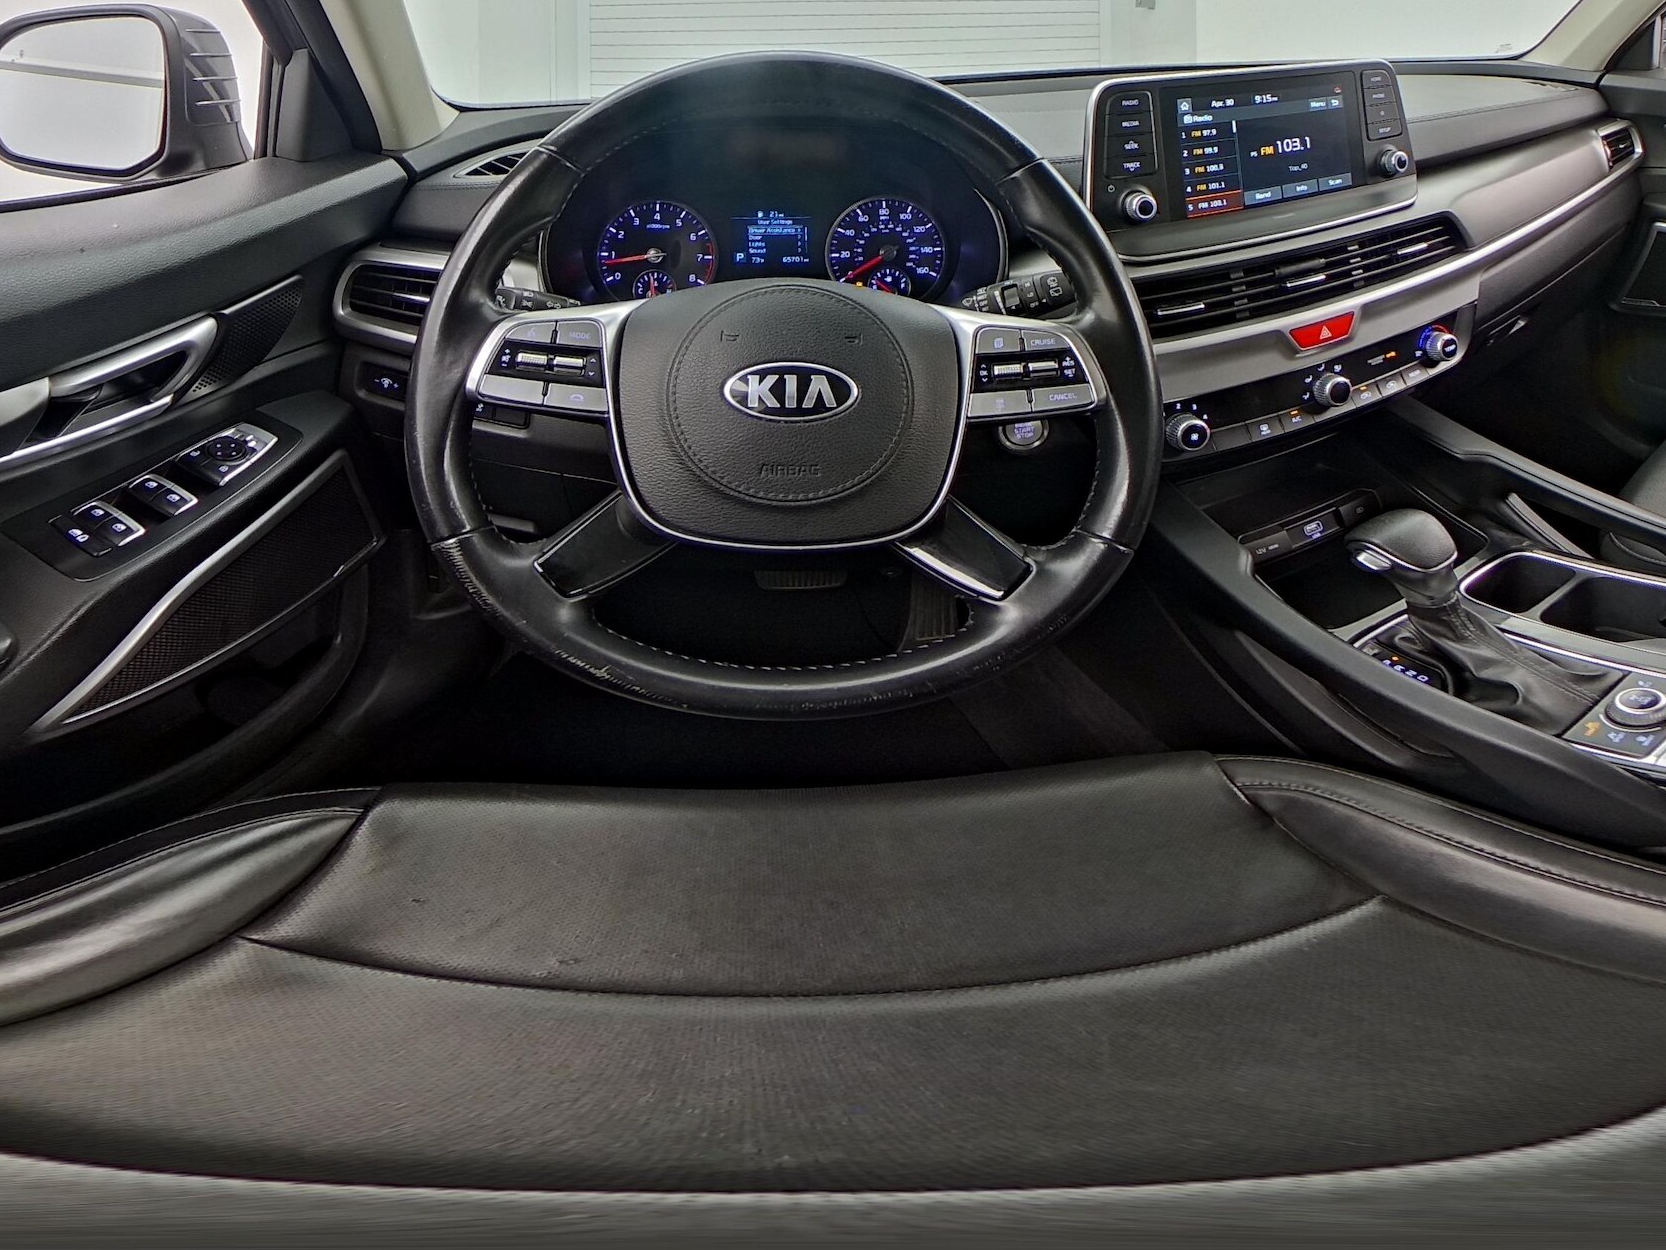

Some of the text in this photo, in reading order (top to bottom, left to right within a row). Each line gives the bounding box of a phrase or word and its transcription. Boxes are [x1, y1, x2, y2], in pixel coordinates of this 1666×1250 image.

[1193, 114, 1213, 123] Radio
[1260, 136, 1311, 156] FM 103.1
[676, 219, 682, 227] 5
[611, 251, 615, 259] 1
[615, 272, 621, 280] 0
[747, 374, 837, 408] KIA
[1049, 392, 1077, 401] CANCEL
[759, 463, 822, 478] AIRBAG
